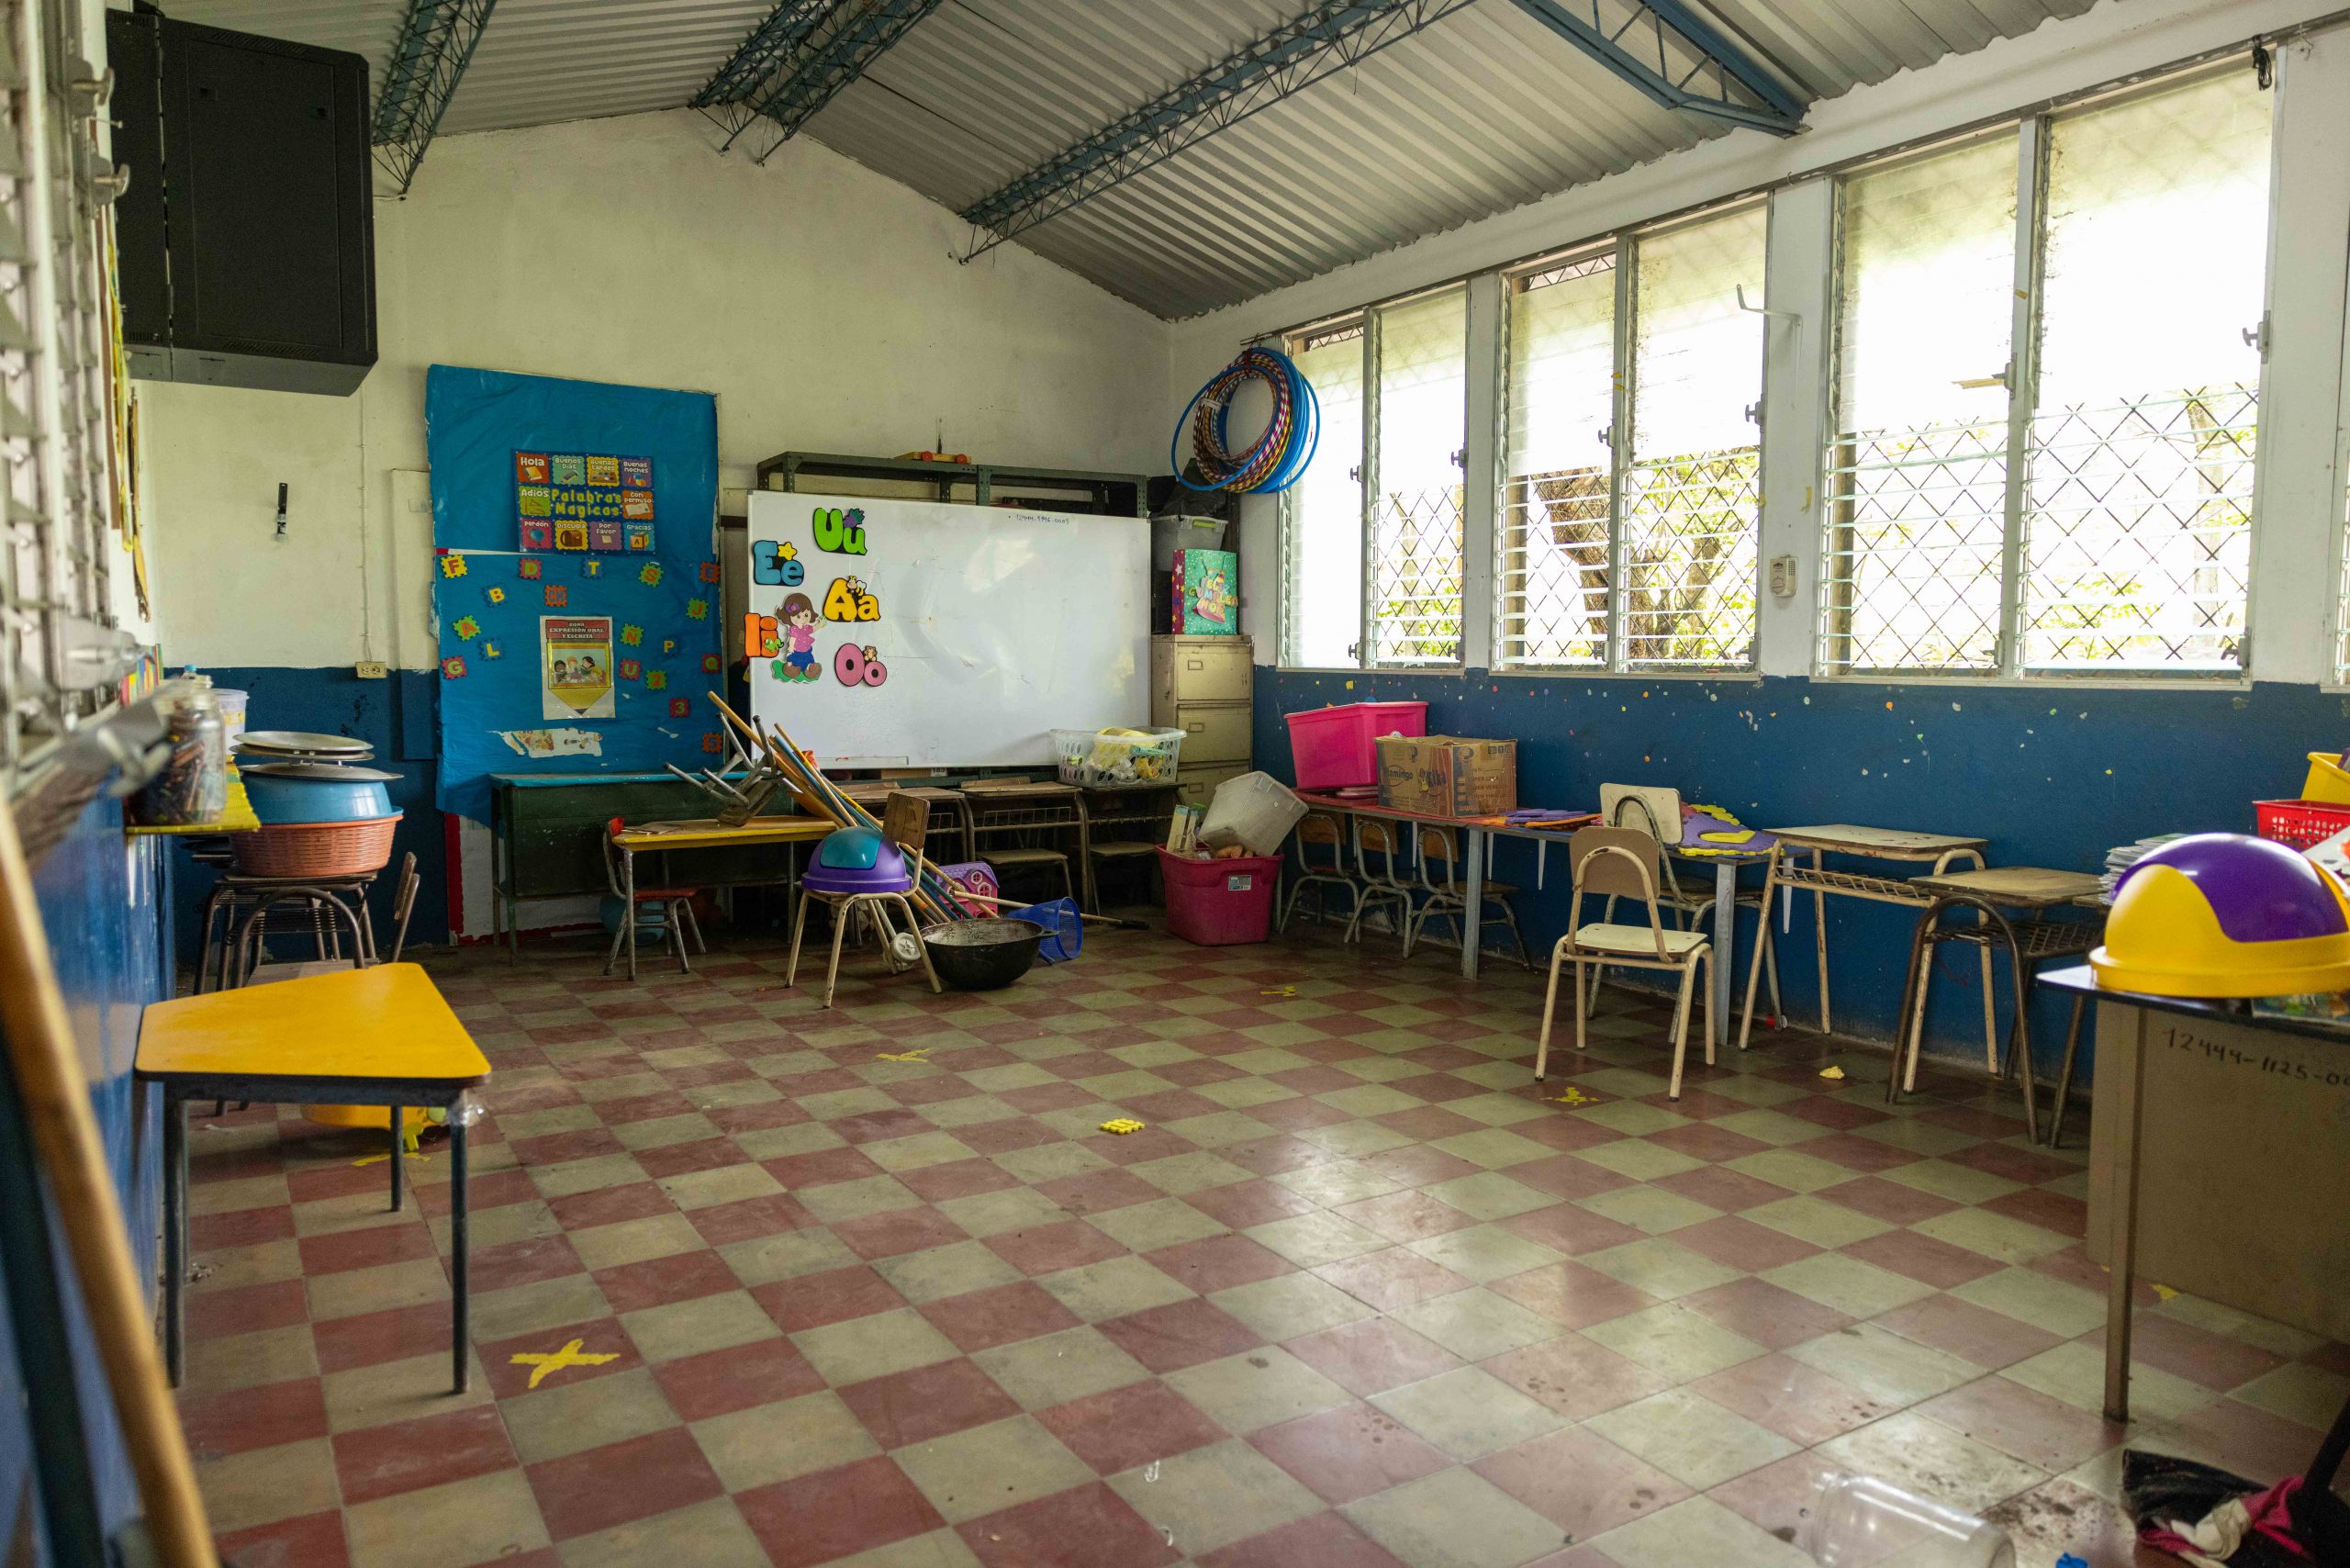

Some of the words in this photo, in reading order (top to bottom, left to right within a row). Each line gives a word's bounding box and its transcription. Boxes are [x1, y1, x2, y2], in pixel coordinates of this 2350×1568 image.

[520, 456, 545, 466] Hola
[552, 488, 621, 503] Palabras
[555, 502, 620, 518] Magicas
[813, 508, 867, 555] Uu
[447, 559, 460, 574] F
[524, 562, 537, 576] D
[588, 561, 600, 575] T
[752, 540, 805, 587] Ee
[644, 567, 658, 582] S
[488, 588, 505, 602] B
[822, 577, 881, 622] Aa
[691, 603, 702, 616] J
[461, 622, 477, 637] A
[626, 628, 638, 643] Ñ
[486, 643, 499, 657] L
[664, 640, 675, 653] P
[447, 660, 463, 675] G
[624, 663, 637, 676] U
[675, 701, 685, 714] 3
